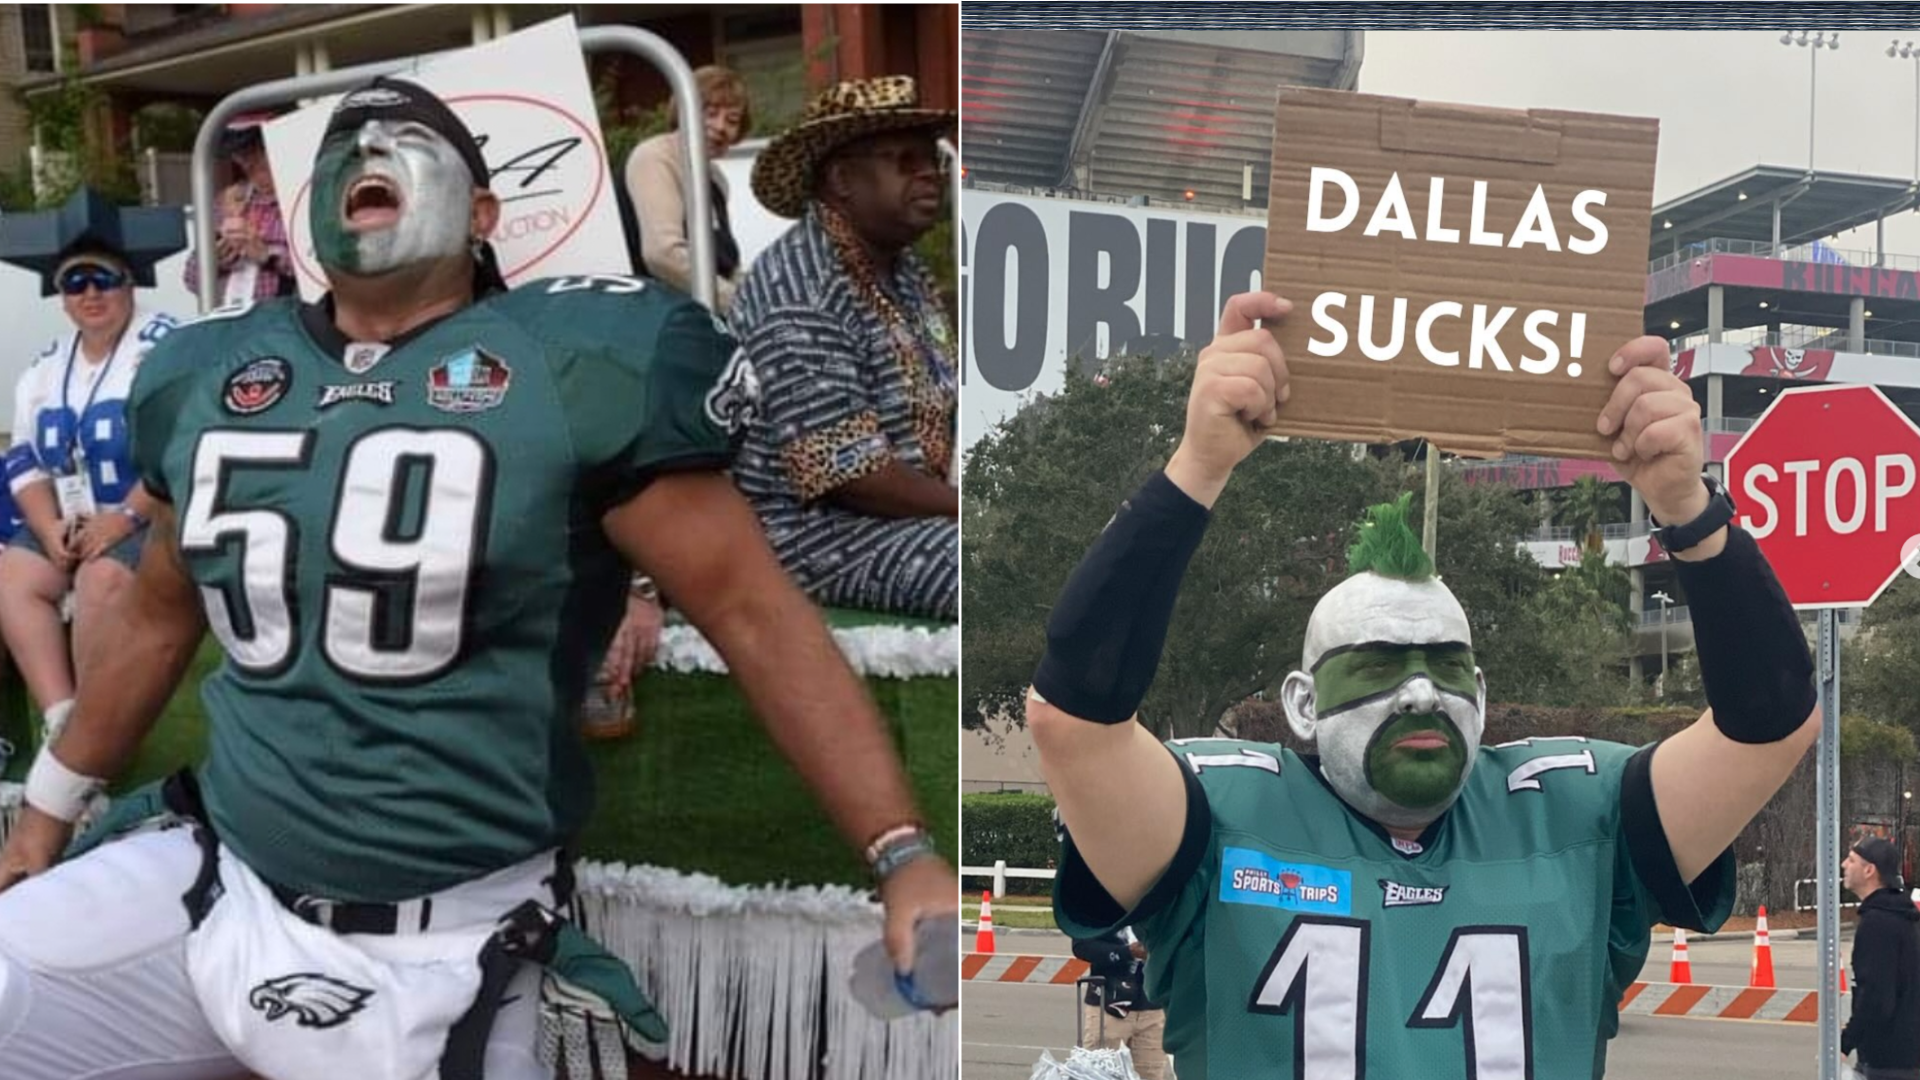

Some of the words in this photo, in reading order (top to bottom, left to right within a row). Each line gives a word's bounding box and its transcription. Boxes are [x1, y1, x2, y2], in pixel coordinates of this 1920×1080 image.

[494, 204, 571, 241] UCTION
[1306, 167, 1609, 255] DALLAS
[1307, 291, 1587, 377] SUCKS!
[319, 382, 395, 406] EAGLES
[1740, 453, 1916, 539] STOP
[180, 427, 496, 688] 59
[1233, 869, 1281, 895] SPORTS
[1300, 885, 1338, 903] TRIPS
[1383, 880, 1446, 908] EAGLES
[1248, 914, 1536, 1080] 11
